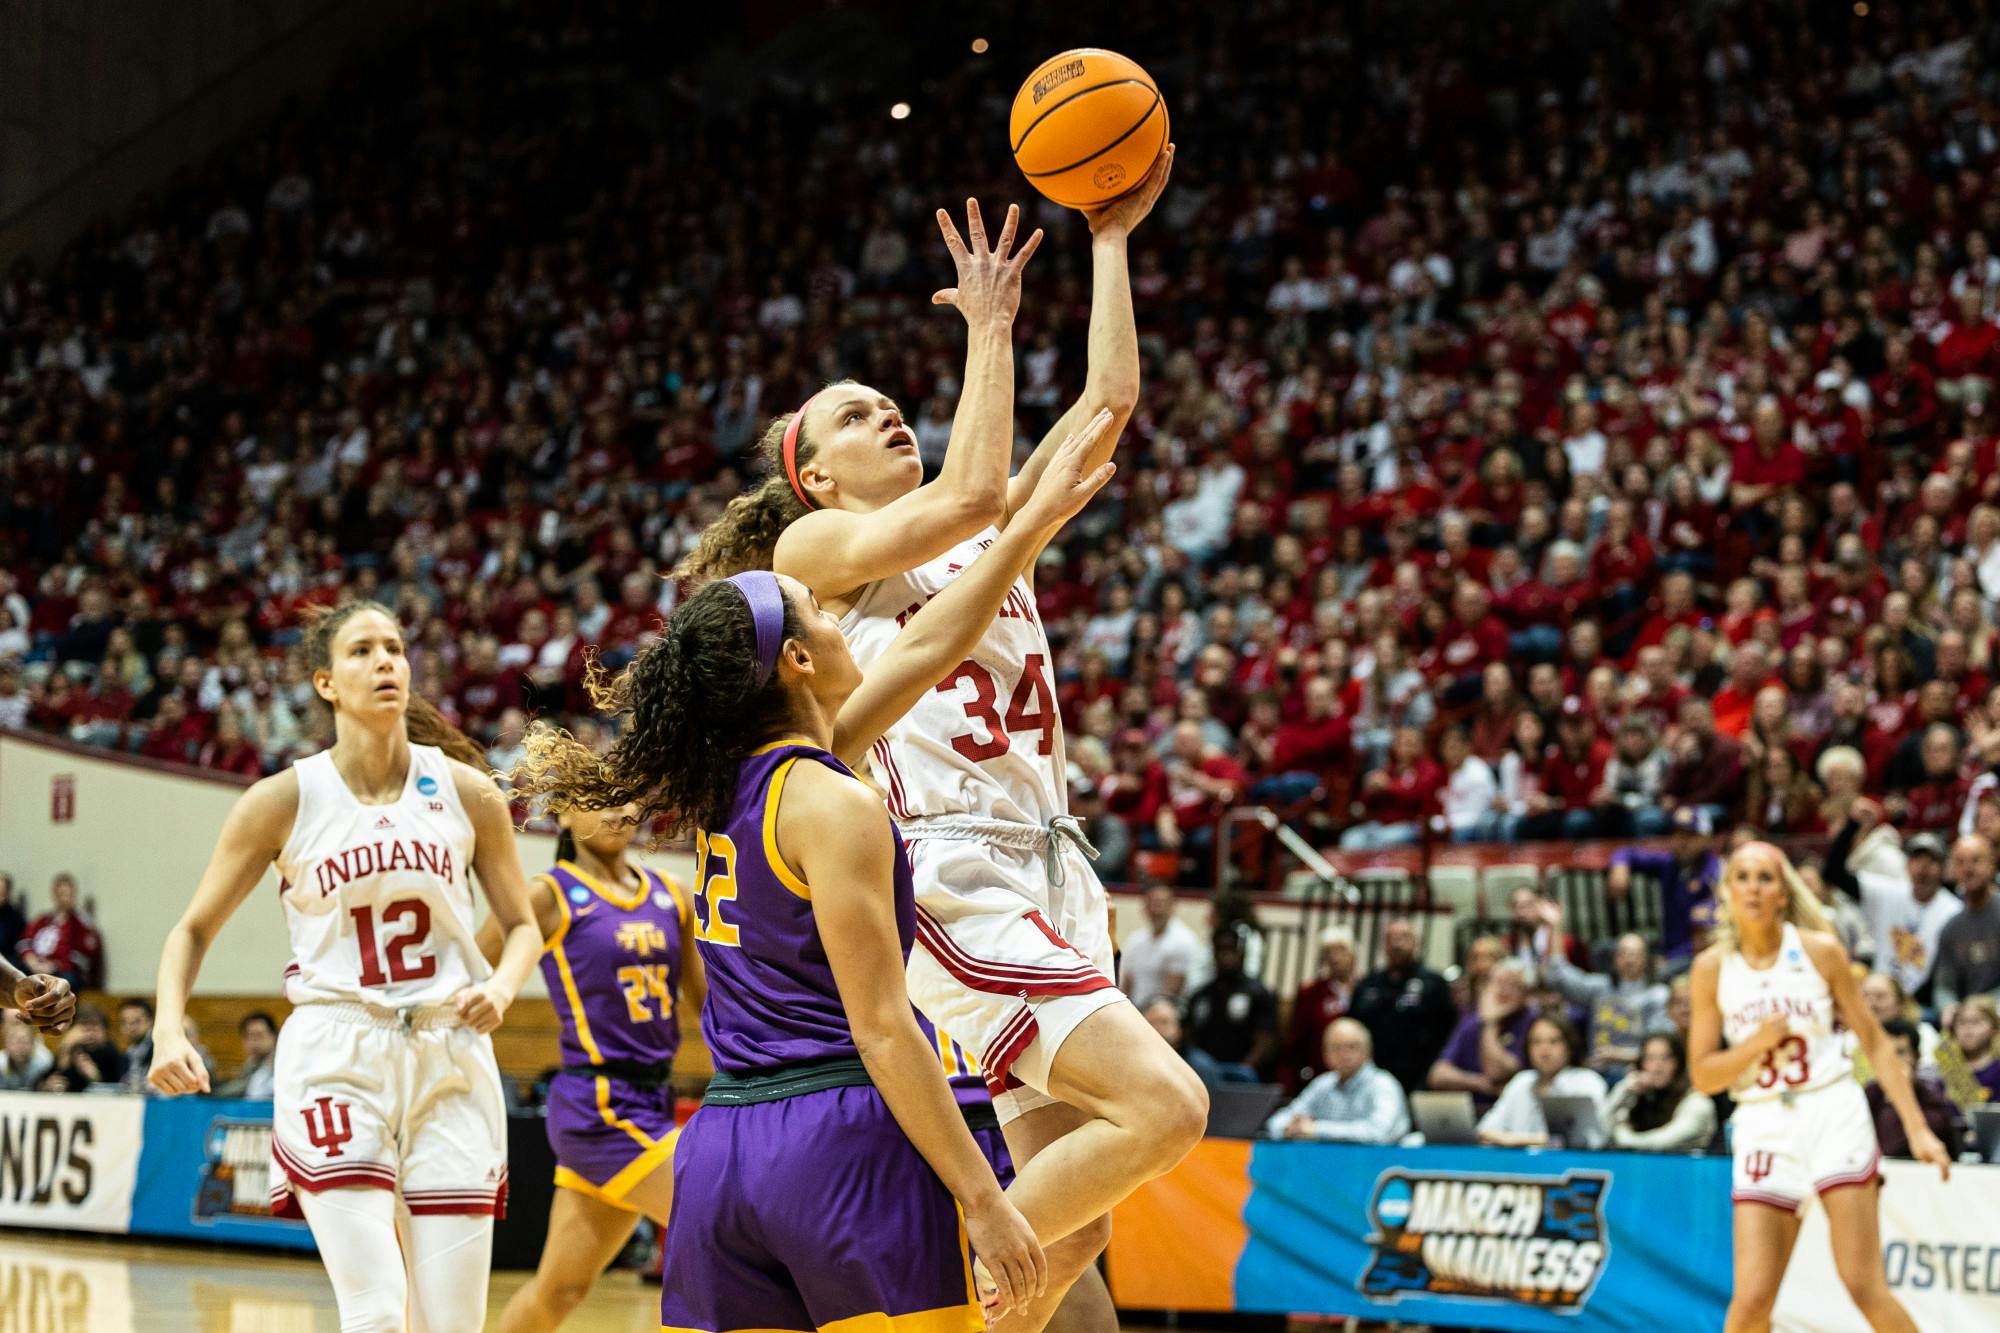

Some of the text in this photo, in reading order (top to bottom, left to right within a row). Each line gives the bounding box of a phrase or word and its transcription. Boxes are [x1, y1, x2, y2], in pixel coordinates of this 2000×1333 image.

[935, 653, 1056, 763] 34
[315, 840, 454, 898] INDIANA
[350, 897, 436, 987] 12
[617, 964, 674, 1024] 24
[1756, 1035, 1809, 1089] 33
[1406, 1180, 1543, 1238] MARCH
[1422, 1232, 1602, 1293] MADNESS
